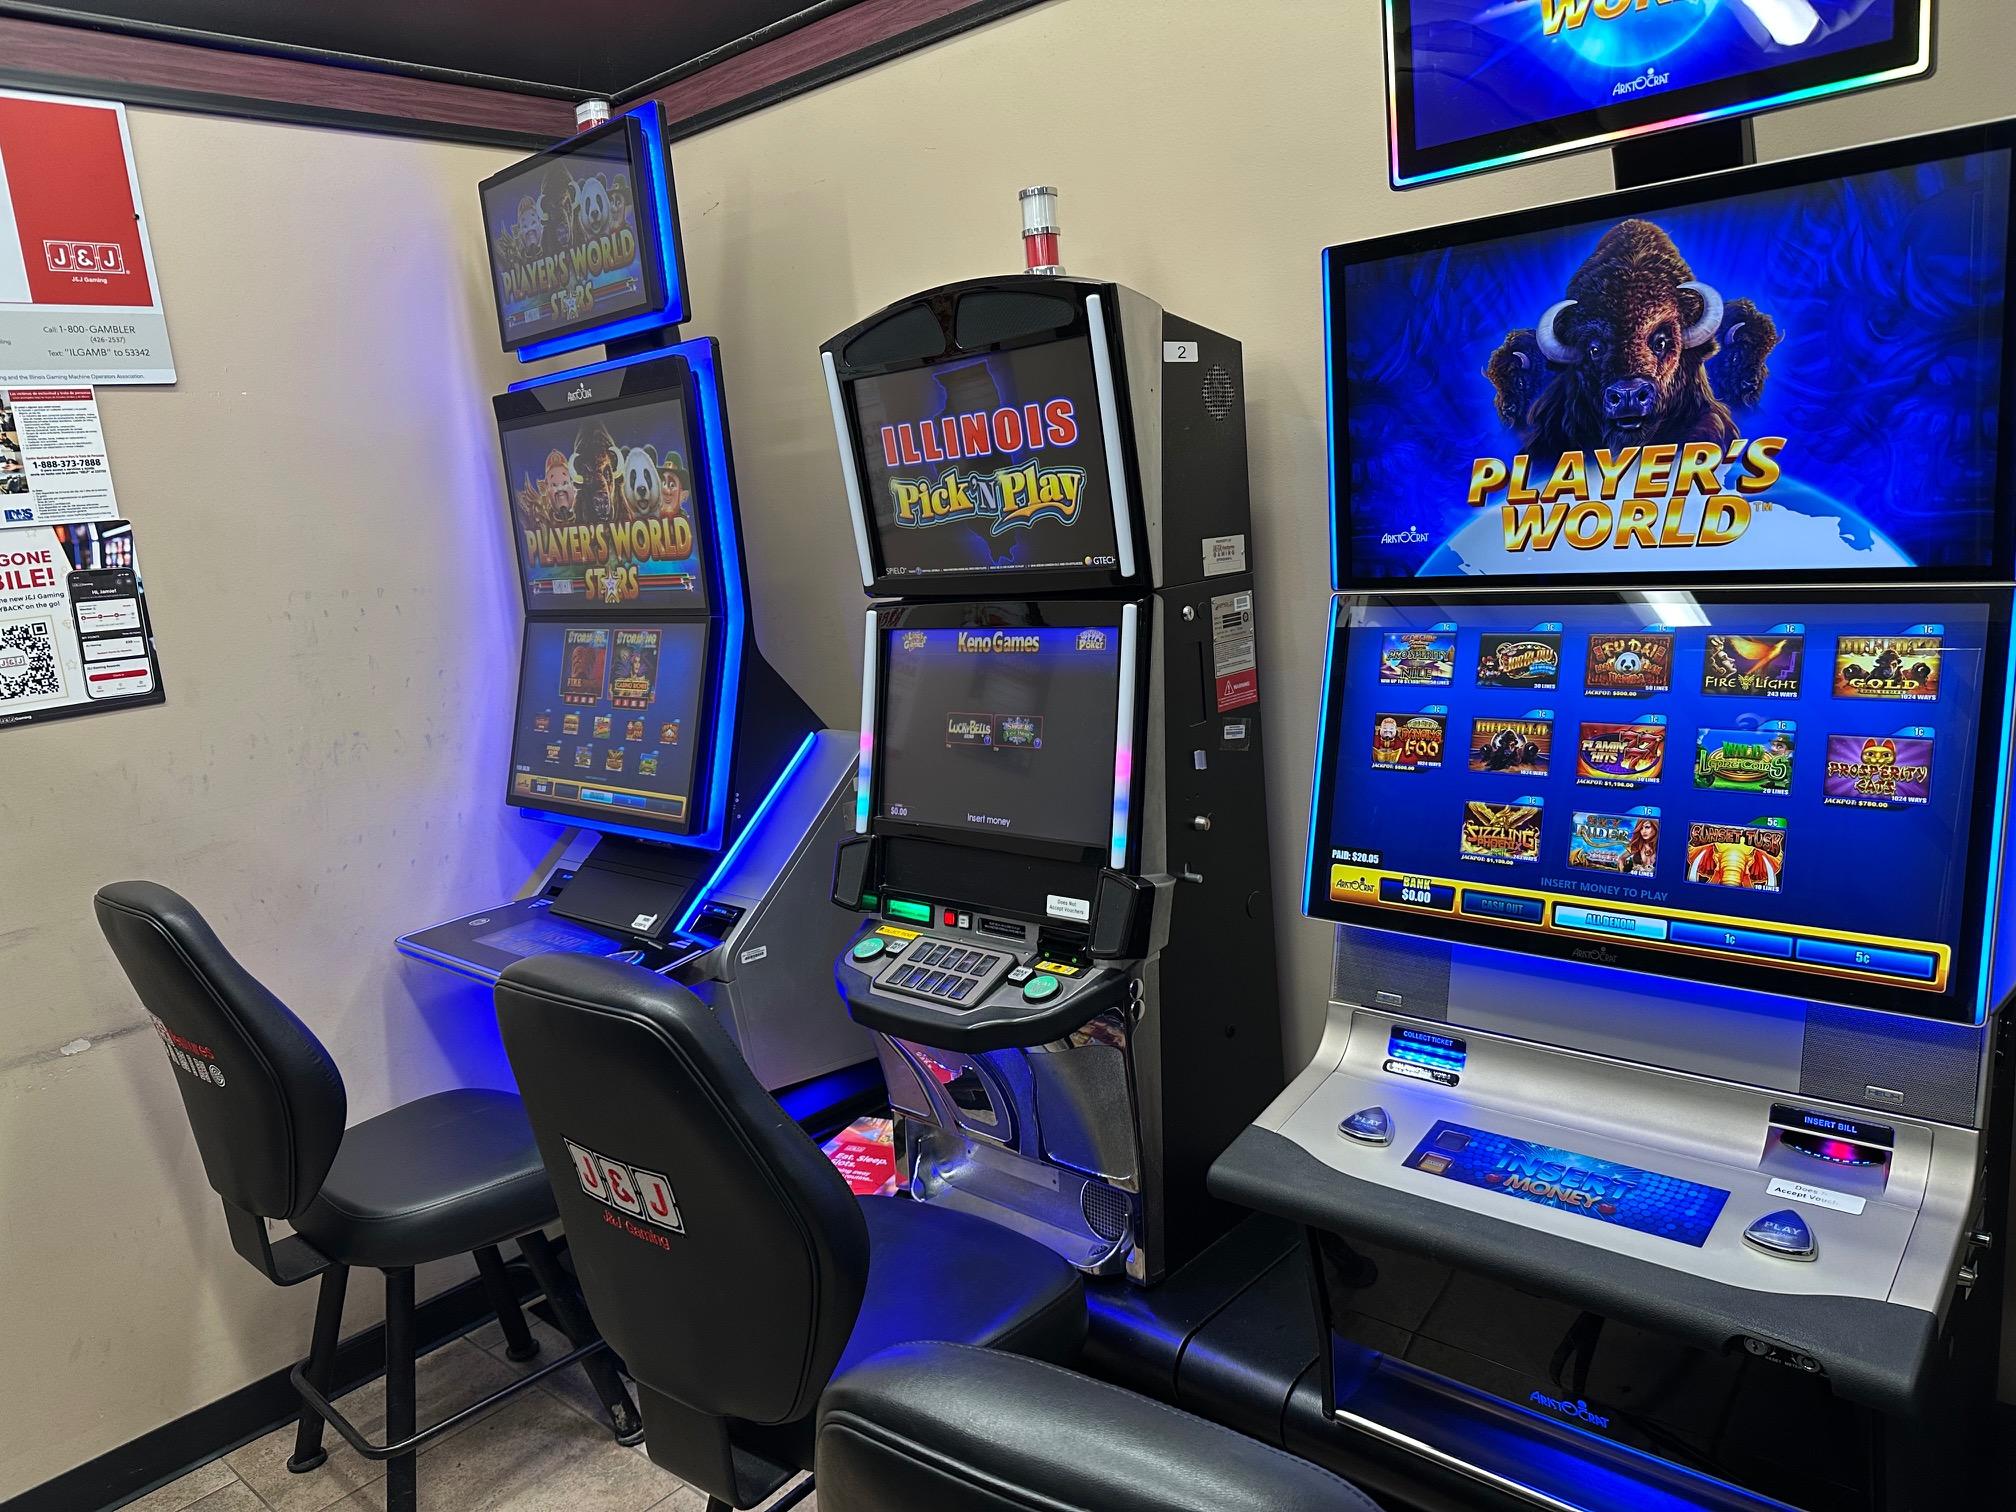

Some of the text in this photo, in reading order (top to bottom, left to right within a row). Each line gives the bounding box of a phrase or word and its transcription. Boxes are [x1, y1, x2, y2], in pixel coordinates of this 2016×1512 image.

[1613, 67, 1669, 96] ARISTOCRAT
[502, 229, 635, 305] PLAYER'S WORLD
[84, 277, 108, 285] Gaming
[59, 325, 136, 335] 1-800-GAMBLER
[113, 349, 124, 357] to
[125, 349, 151, 357] 53342
[1177, 346, 1187, 359] 2
[881, 399, 1078, 466] ILLINOIS
[33, 458, 101, 469] 1-888-373-7888
[1467, 436, 1787, 507] PLAYER'S
[898, 468, 973, 519] Pick
[1000, 462, 1085, 522] Play
[1500, 496, 1754, 553] WORLD
[525, 516, 693, 568] PLAYER'S WORLD
[1381, 525, 1430, 545] ARISTOCRAT
[37, 592, 65, 600] Gaming
[49, 601, 60, 609] go!
[957, 630, 1040, 653] Keno Games
[1704, 676, 1798, 690] FIRE LIGHT
[1849, 678, 1920, 690] GOLD
[1405, 739, 1439, 756] FOO
[1590, 751, 1618, 763] HITS
[1827, 761, 1928, 783] PROSPERITY
[1854, 777, 1897, 795] CATS
[1824, 798, 1858, 806] JACKPOT:
[1908, 796, 1928, 804] WAYS
[890, 806, 908, 816] $0.00
[967, 813, 1011, 828] Insert money
[1466, 826, 1535, 851] SIZZLING
[1576, 823, 1630, 841] RIDER
[1690, 824, 1784, 857] SUNSET TUSK
[1331, 849, 1379, 864] PAID: $20.05
[1402, 876, 1432, 890] BANK
[1540, 877, 1668, 901] INSERT MONEY TO PLAY
[1401, 888, 1432, 904] $0.00
[1049, 904, 1064, 912] Accept
[1481, 899, 1524, 914] CASH OUT
[1585, 913, 1636, 930] ALL DENOM
[1403, 1030, 1454, 1047] COLLECT TICKET
[1354, 1113, 1383, 1127] PLAY
[1803, 1116, 1858, 1134] INSERT BILL
[1496, 1150, 1637, 1200] INSERT
[1503, 1174, 1601, 1209] MONEY
[1774, 1186, 1842, 1207] Accept Vouch
[625, 1219, 671, 1251] Gaming
[1764, 1221, 1802, 1235] PLAY
[1529, 1390, 1610, 1429] ARISTOCRAT
